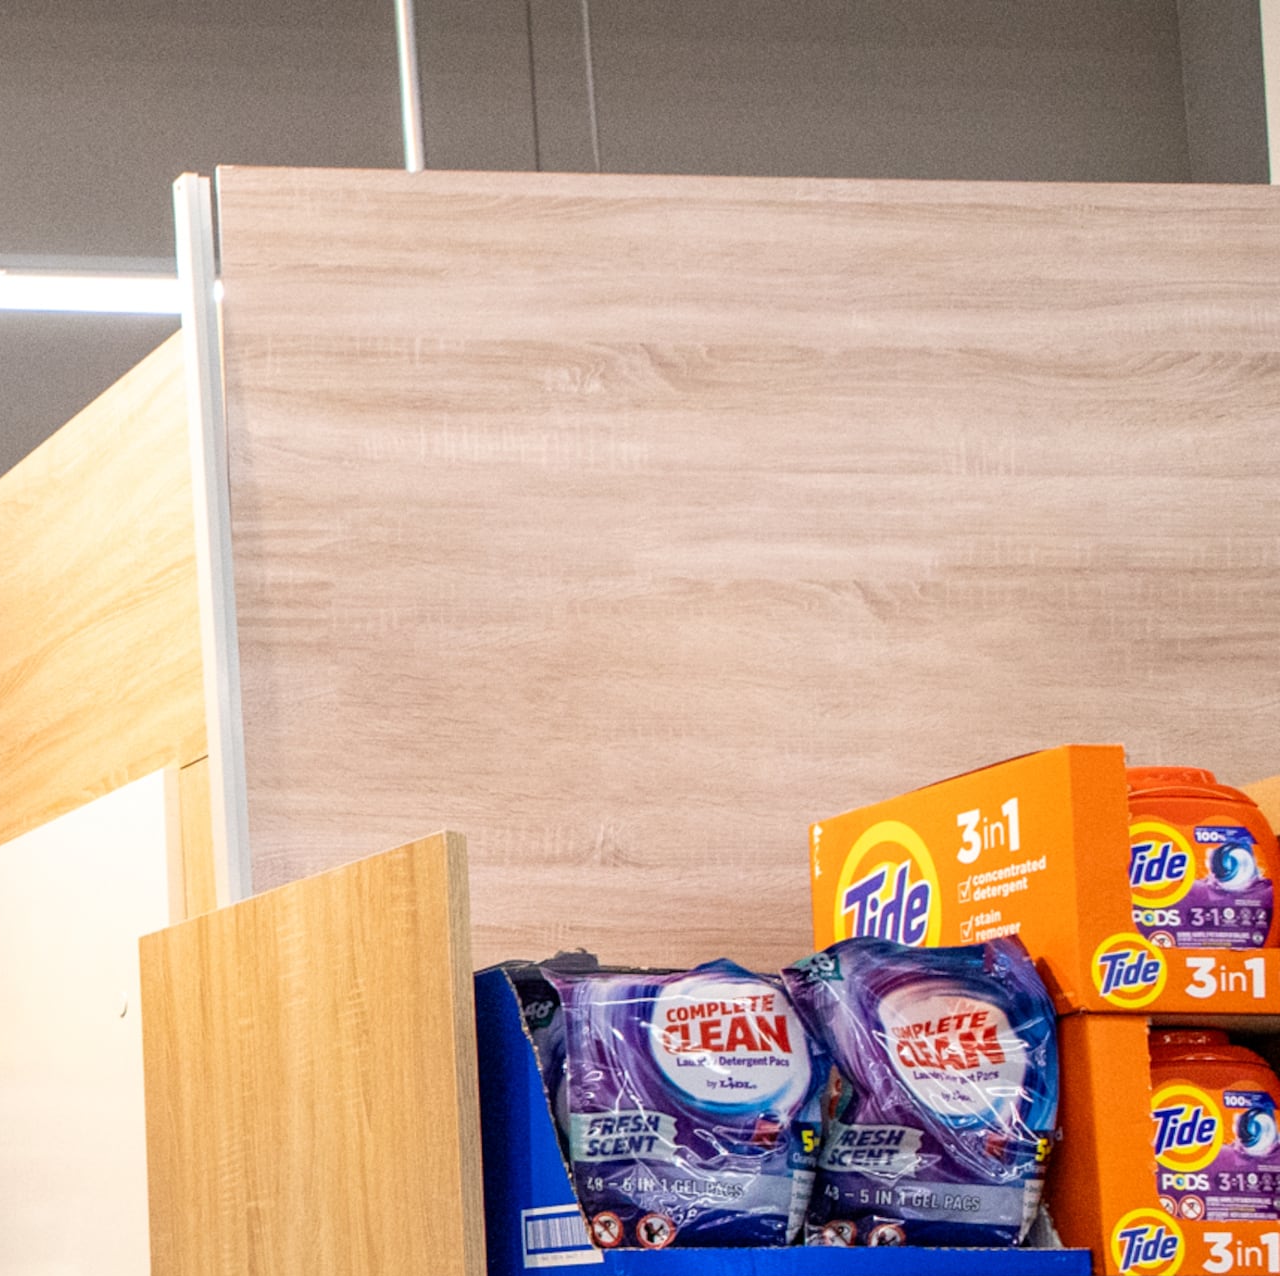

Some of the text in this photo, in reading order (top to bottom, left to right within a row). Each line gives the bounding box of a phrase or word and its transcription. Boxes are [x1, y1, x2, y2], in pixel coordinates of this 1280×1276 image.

[957, 797, 1020, 864] 3in1
[973, 856, 1047, 887] concentrated
[1130, 842, 1188, 887] Tide
[842, 860, 931, 947] Tide
[973, 877, 1029, 902] detergent
[975, 910, 1002, 928] stain
[976, 922, 1021, 941] remover
[1100, 951, 1161, 997] Tide
[1185, 957, 1267, 999] 3in1
[666, 994, 775, 1022] COMPLETE
[662, 1015, 793, 1056] CLEAN
[896, 1026, 1007, 1070] CLEAN
[719, 1056, 768, 1067] Detergent
[769, 1056, 790, 1067] Pacs
[706, 1077, 753, 1090] by LIDL
[589, 1115, 661, 1136] FRESH
[1151, 1106, 1218, 1158] Tide
[586, 1135, 659, 1157] SCENT
[827, 1150, 896, 1166] SCENT
[586, 1177, 604, 1192] 48
[637, 1177, 655, 1192] IN
[674, 1179, 699, 1195] GEL
[705, 1182, 744, 1198] PACS
[1161, 1173, 1210, 1191] PODS
[860, 1190, 870, 1204] 5
[875, 1190, 893, 1205] IN
[912, 1192, 939, 1208] GEL
[944, 1195, 981, 1211] PACS
[1119, 1227, 1179, 1273] Tide
[1202, 1232, 1280, 1274] 3in1
